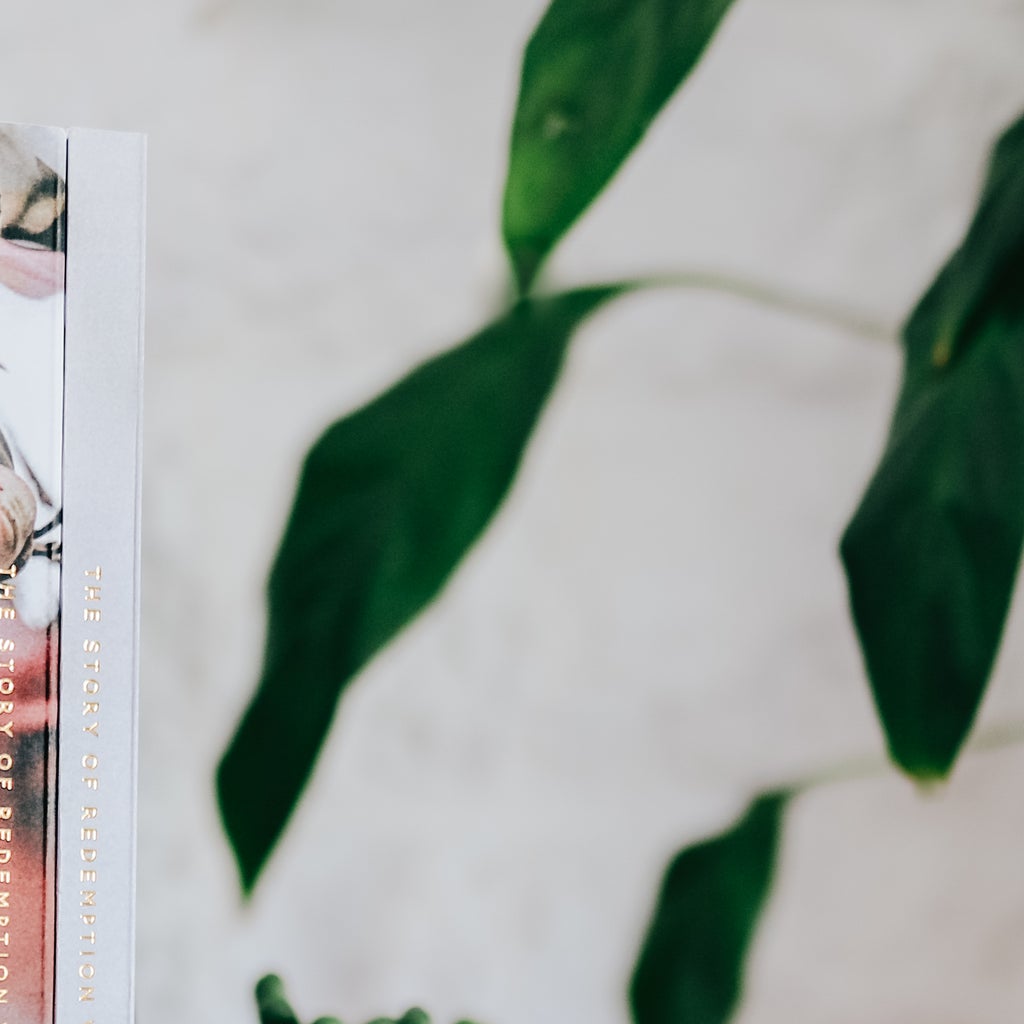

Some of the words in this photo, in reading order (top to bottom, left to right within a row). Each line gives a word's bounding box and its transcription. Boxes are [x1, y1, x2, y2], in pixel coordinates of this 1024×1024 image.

[83, 565, 102, 622] THE
[82, 638, 101, 738] STORY
[81, 753, 99, 791] OF
[78, 805, 98, 1003] REDEMPTION
